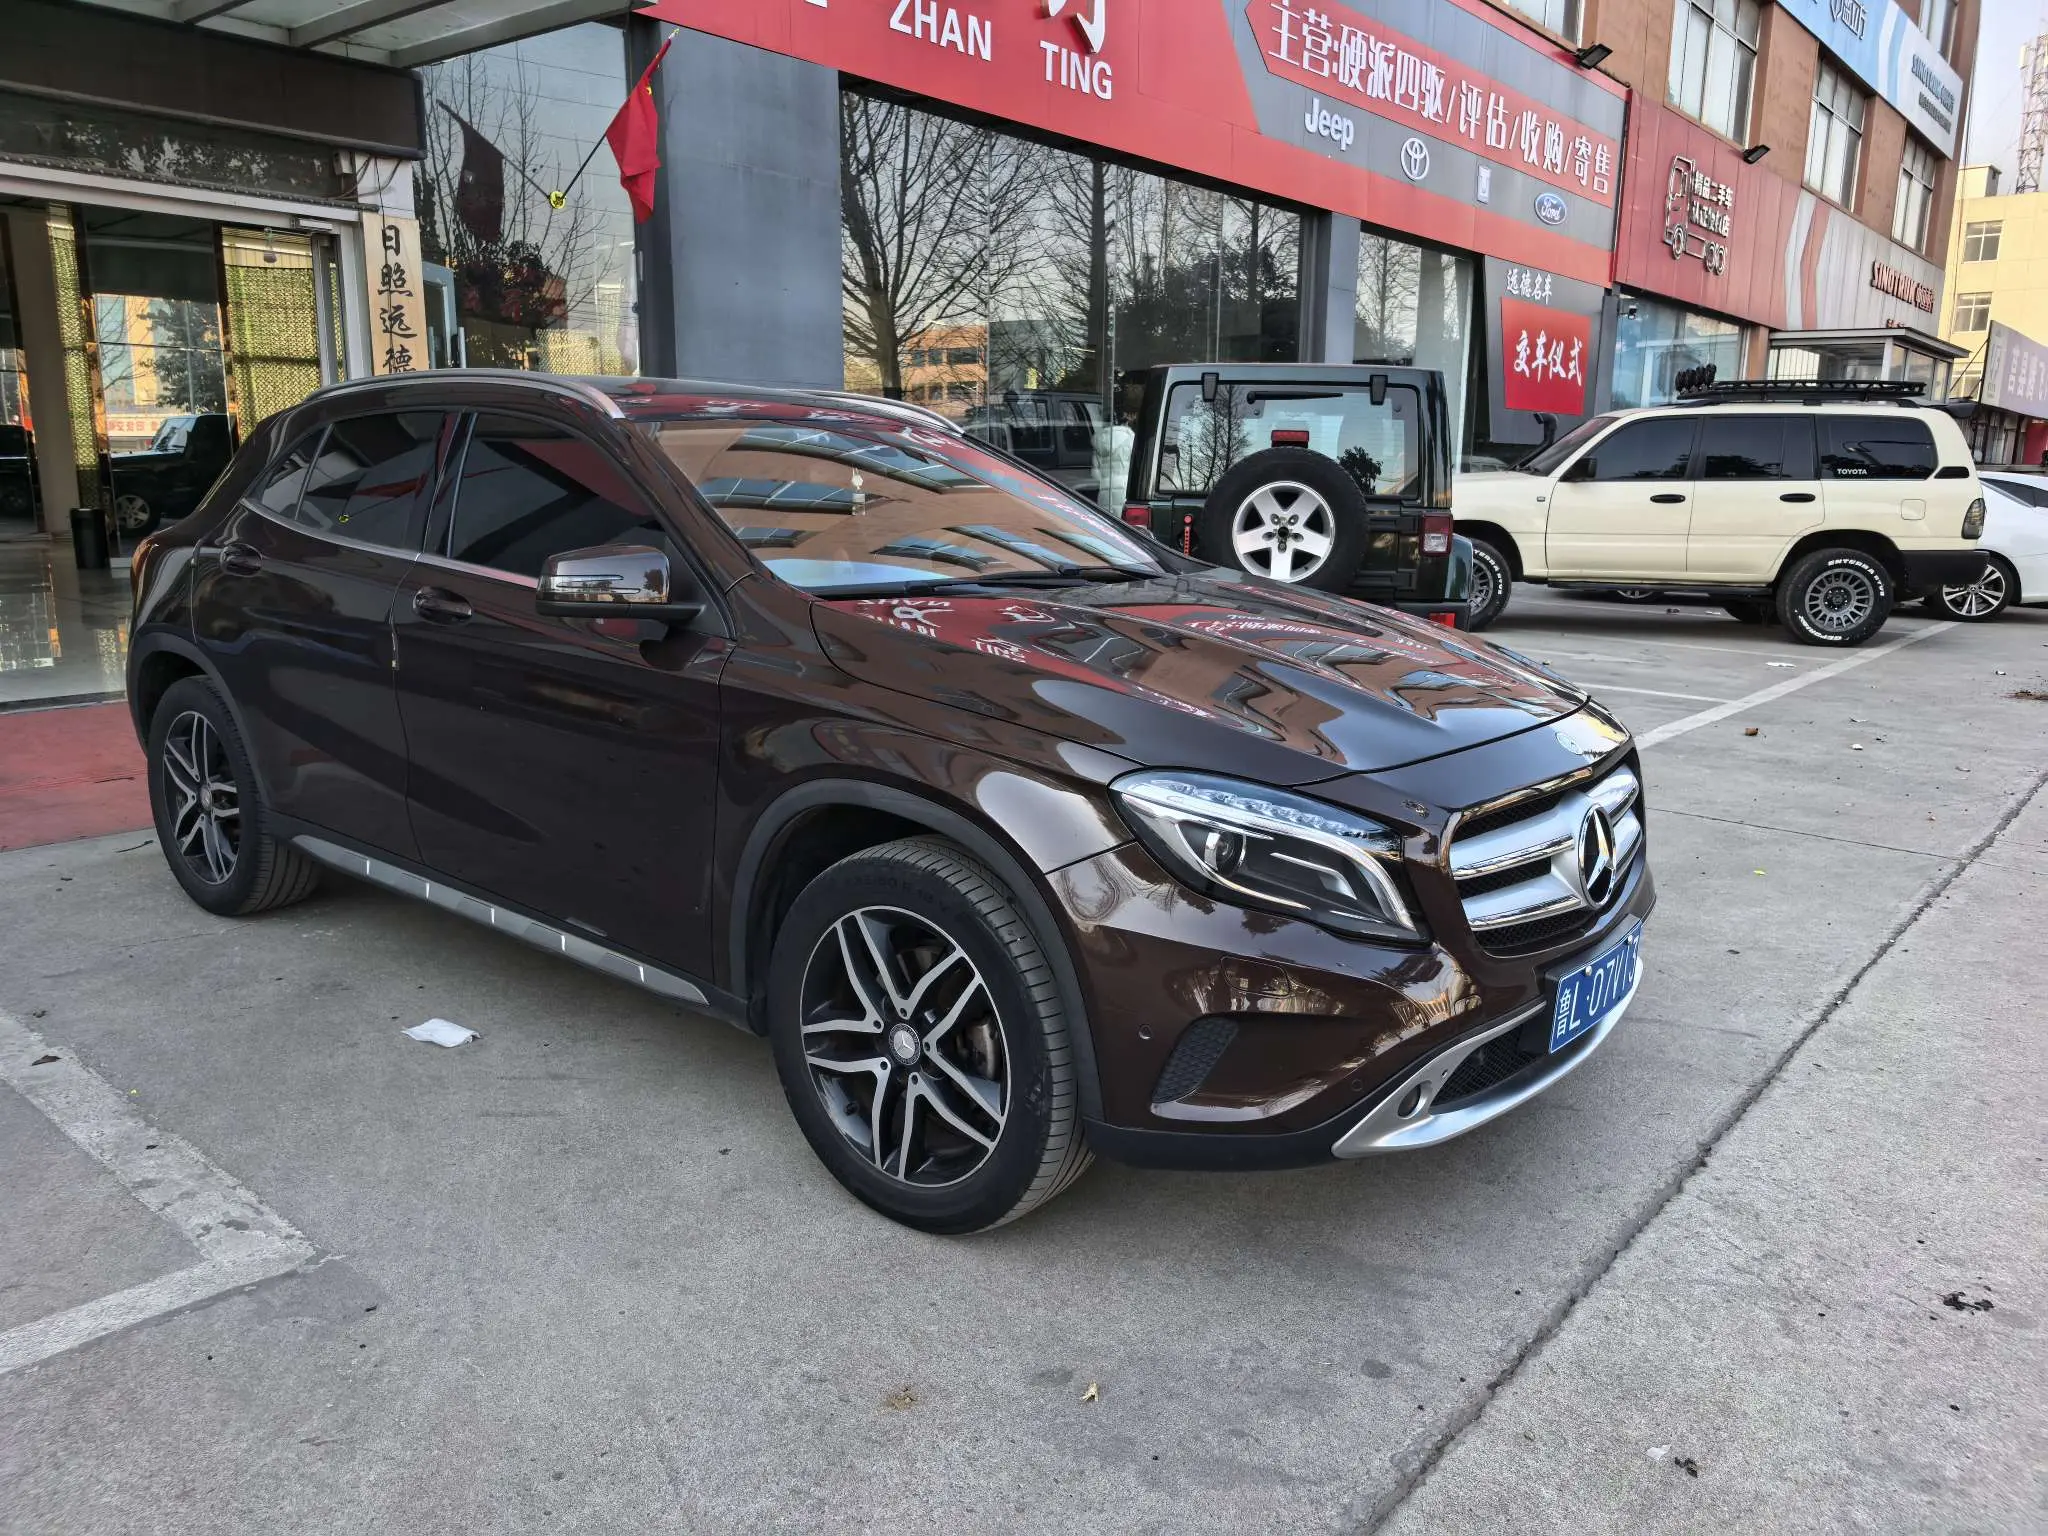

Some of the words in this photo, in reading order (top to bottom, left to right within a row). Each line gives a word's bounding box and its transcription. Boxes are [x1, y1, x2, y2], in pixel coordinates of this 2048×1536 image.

[890, 0, 992, 61] ZHAN
[1039, 40, 1112, 100] TING
[1304, 97, 1355, 151] Jeep
[378, 224, 417, 373] 日照远德
[1514, 329, 1583, 387] 交车仪式
